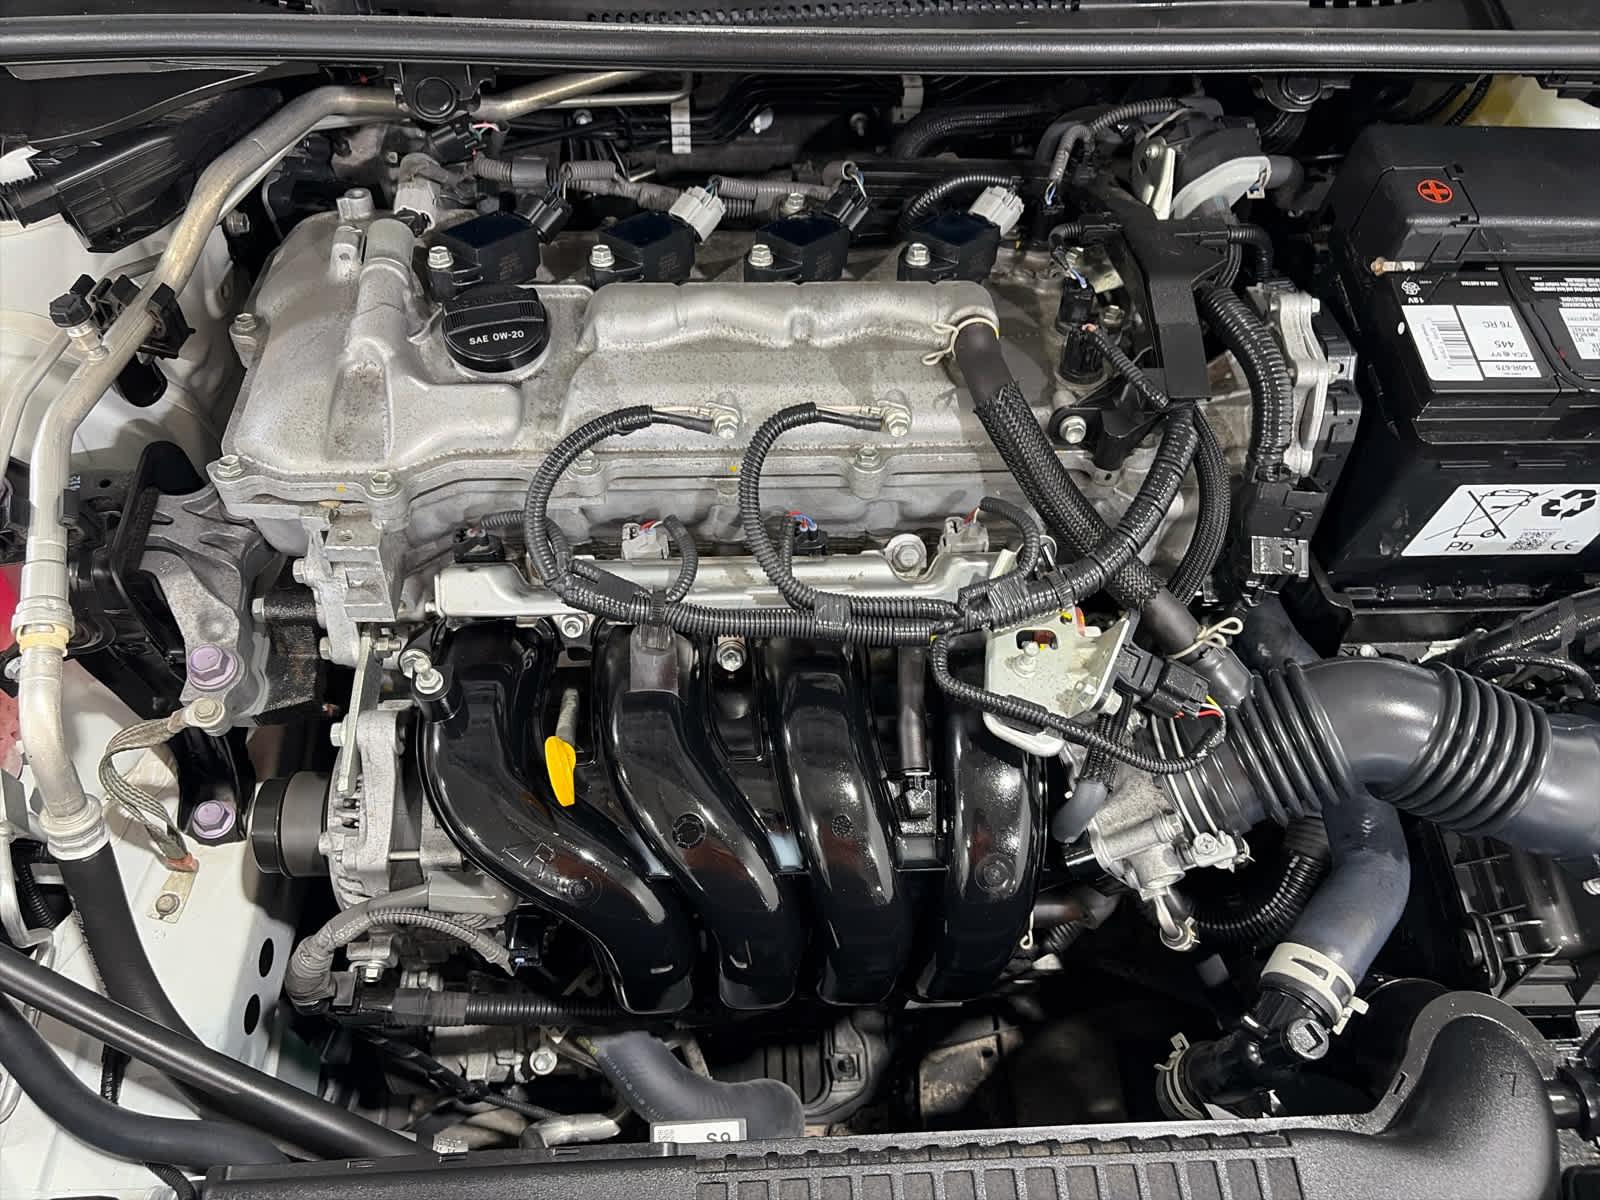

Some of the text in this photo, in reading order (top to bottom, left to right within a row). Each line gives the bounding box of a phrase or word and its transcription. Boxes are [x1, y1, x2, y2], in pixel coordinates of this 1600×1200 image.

[469, 330, 525, 345] SAE 0W-20
[1494, 340, 1514, 348] 445
[1445, 541, 1474, 552] Pb
